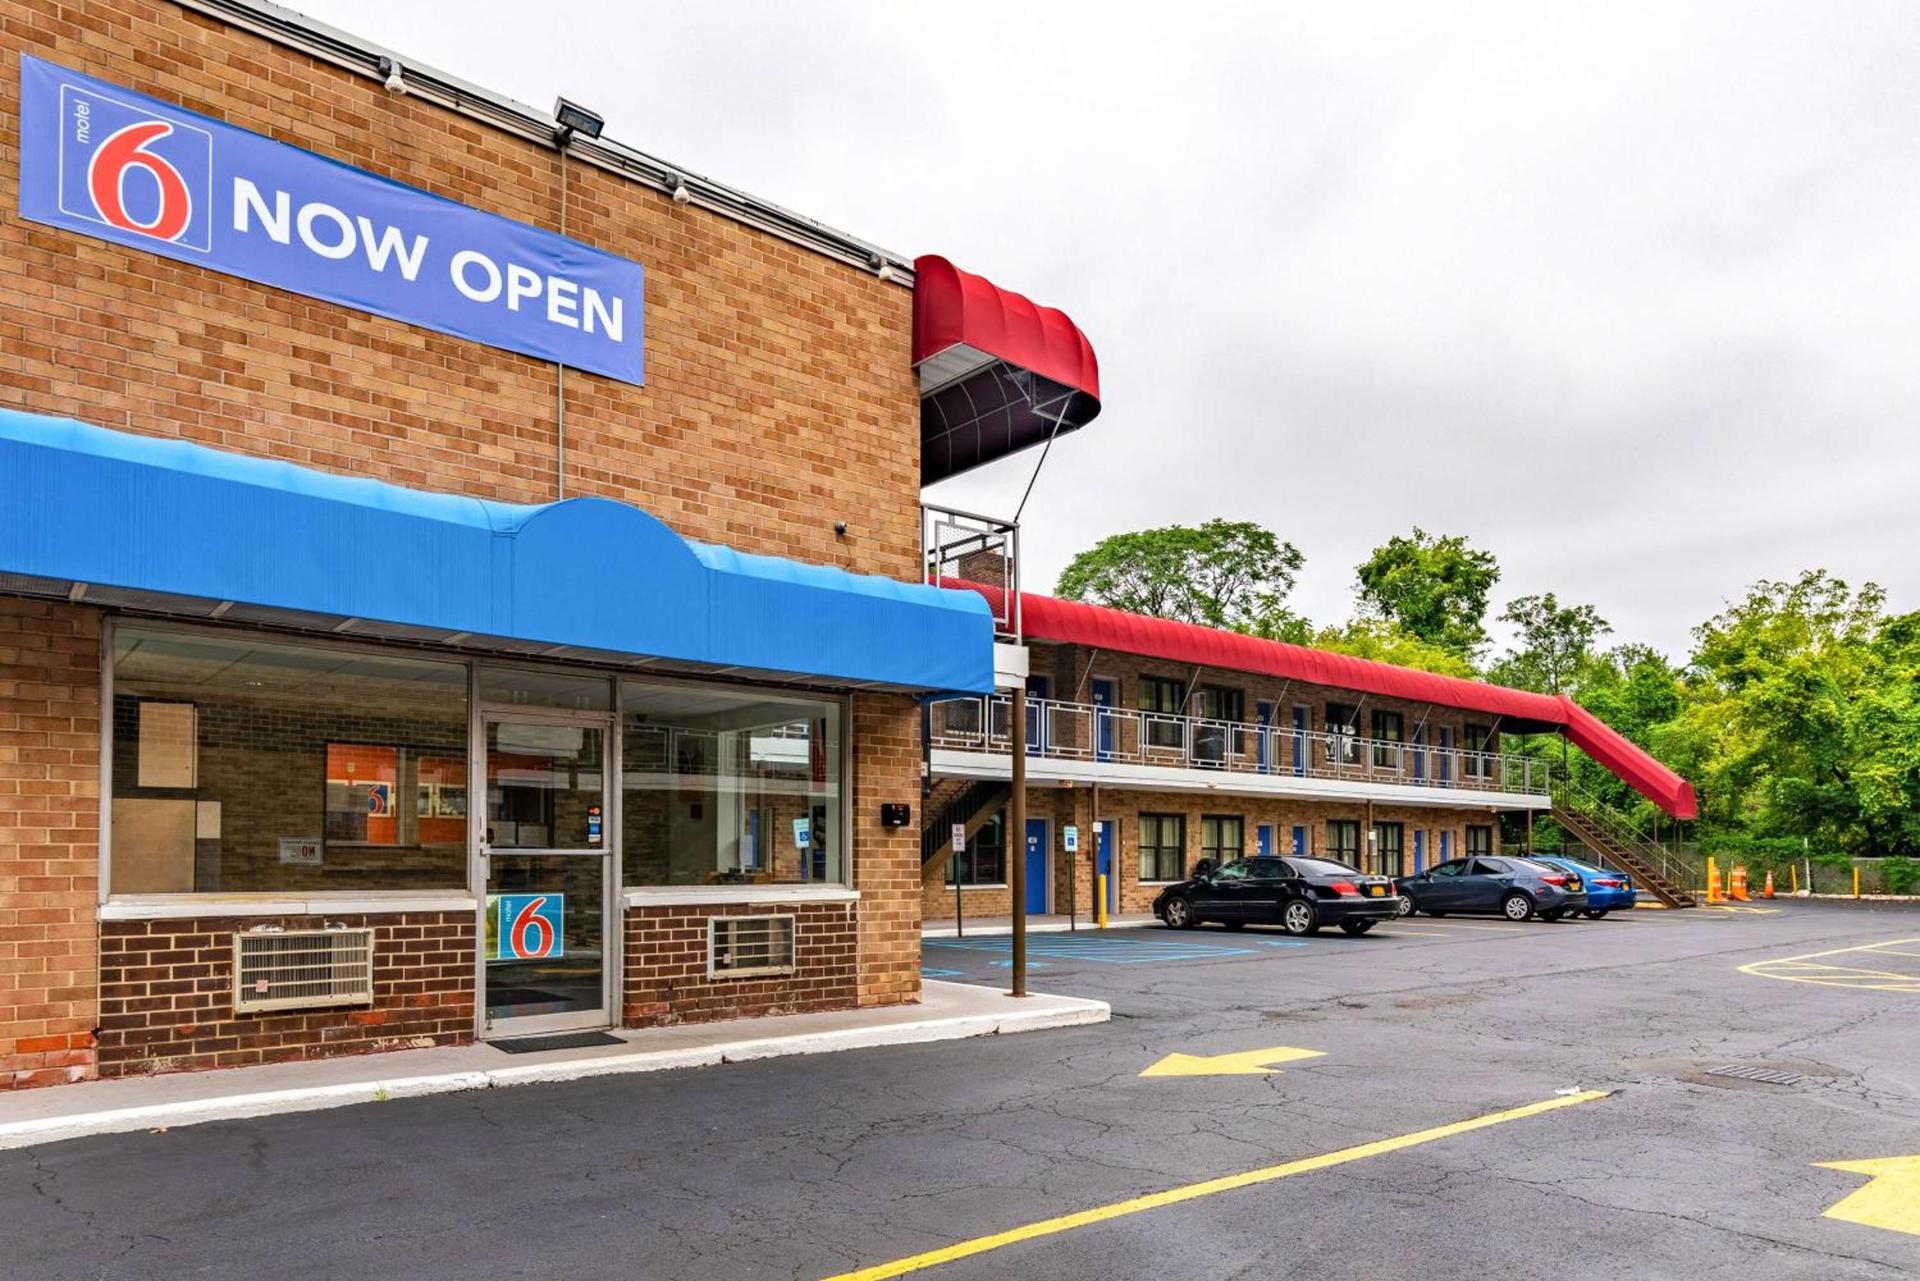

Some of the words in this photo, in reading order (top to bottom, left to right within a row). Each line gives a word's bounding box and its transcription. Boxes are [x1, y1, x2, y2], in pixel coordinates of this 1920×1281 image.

[73, 98, 90, 144] motel
[87, 120, 192, 242] 6
[233, 176, 429, 282] NOW
[450, 250, 623, 343] OPEN
[510, 896, 555, 959] 6
